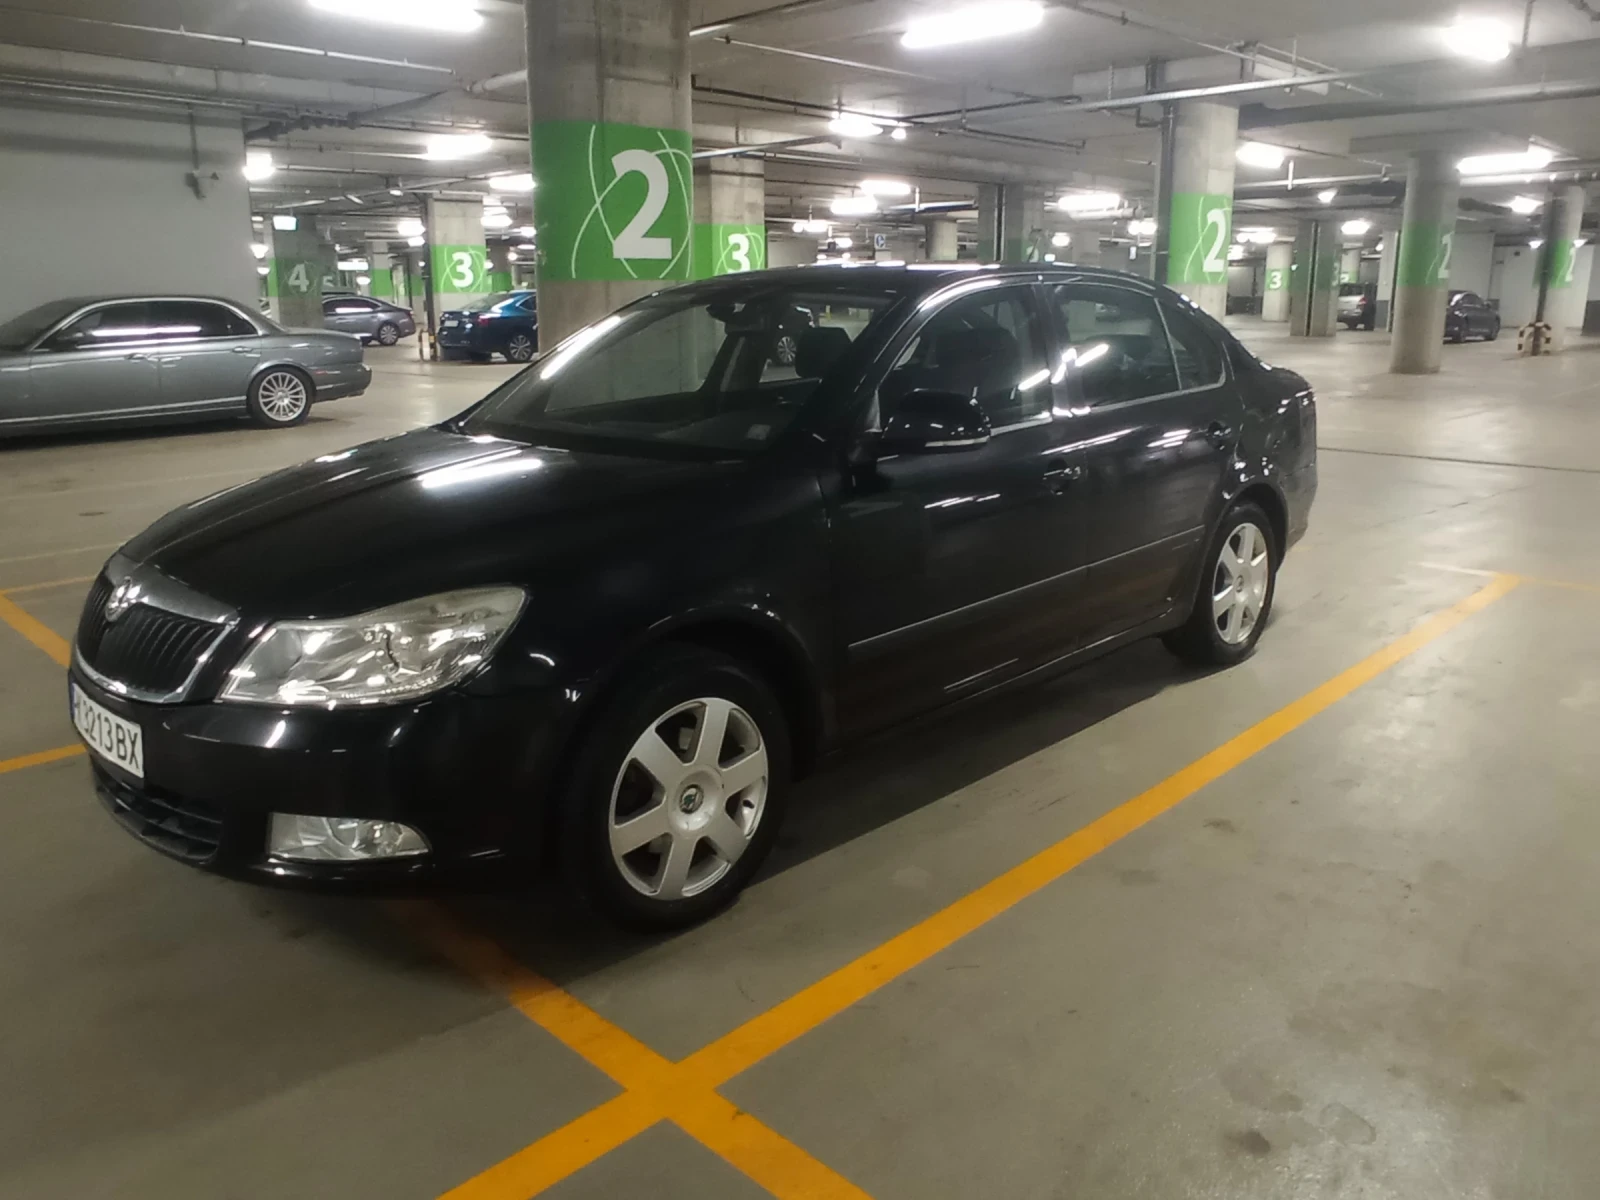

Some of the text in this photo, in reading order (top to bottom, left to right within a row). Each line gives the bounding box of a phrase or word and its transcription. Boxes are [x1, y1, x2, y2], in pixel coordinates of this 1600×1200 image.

[611, 149, 672, 259] 2
[728, 233, 750, 273] 3
[1203, 208, 1226, 272] 2
[288, 264, 310, 292] 4
[451, 251, 474, 288] 3
[1269, 271, 1282, 289] 3
